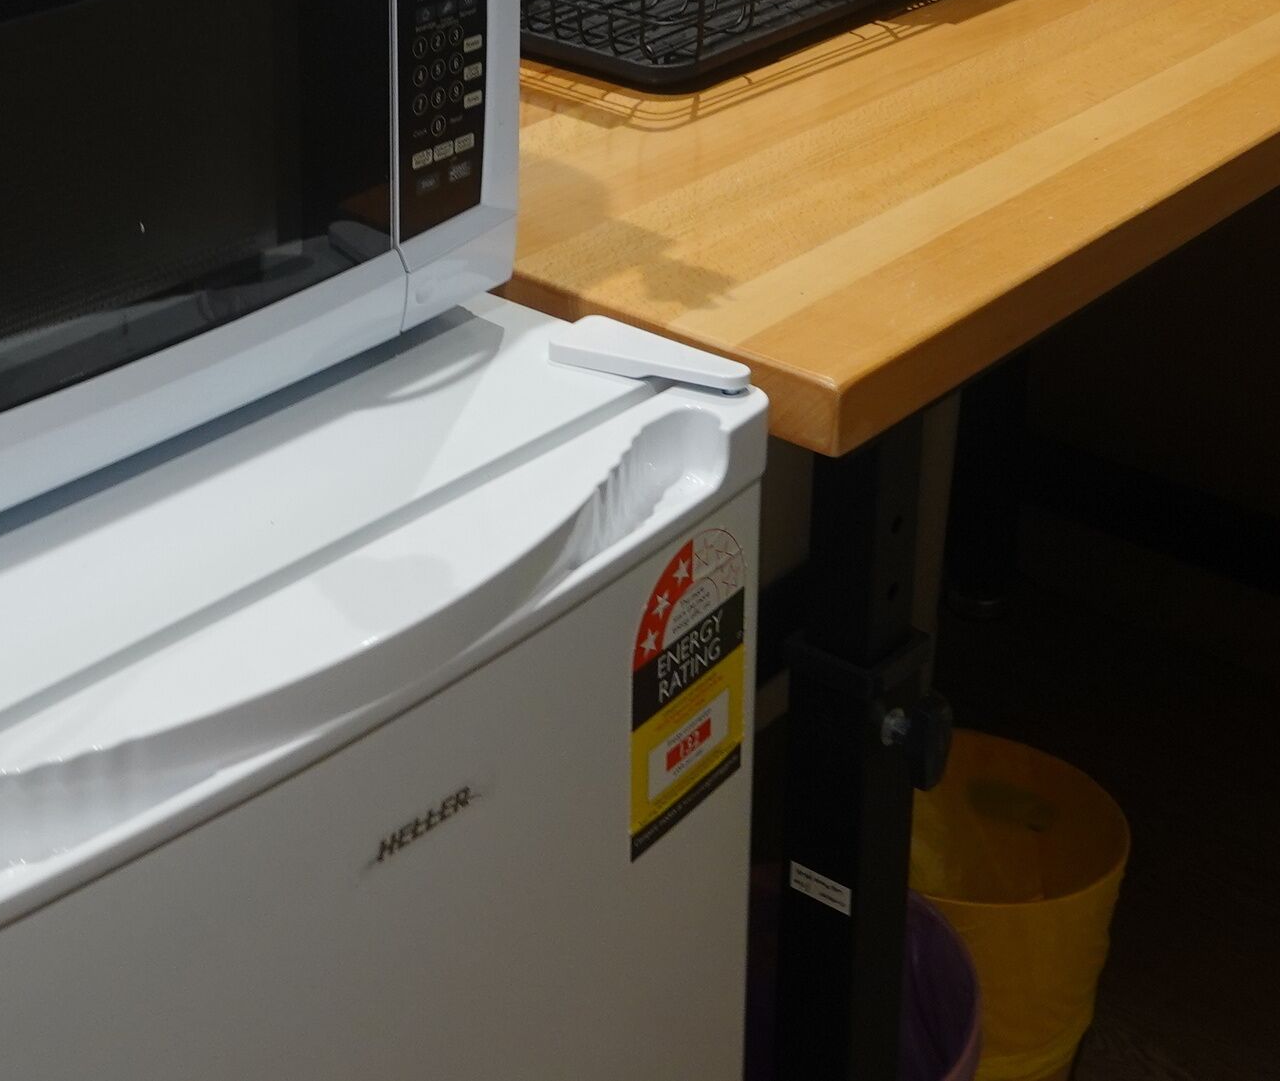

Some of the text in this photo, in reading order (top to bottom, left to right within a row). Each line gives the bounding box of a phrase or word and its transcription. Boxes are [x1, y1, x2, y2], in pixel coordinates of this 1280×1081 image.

[656, 609, 723, 679] ENERGY
[658, 637, 721, 703] RATING
[375, 786, 471, 861] HELLER
